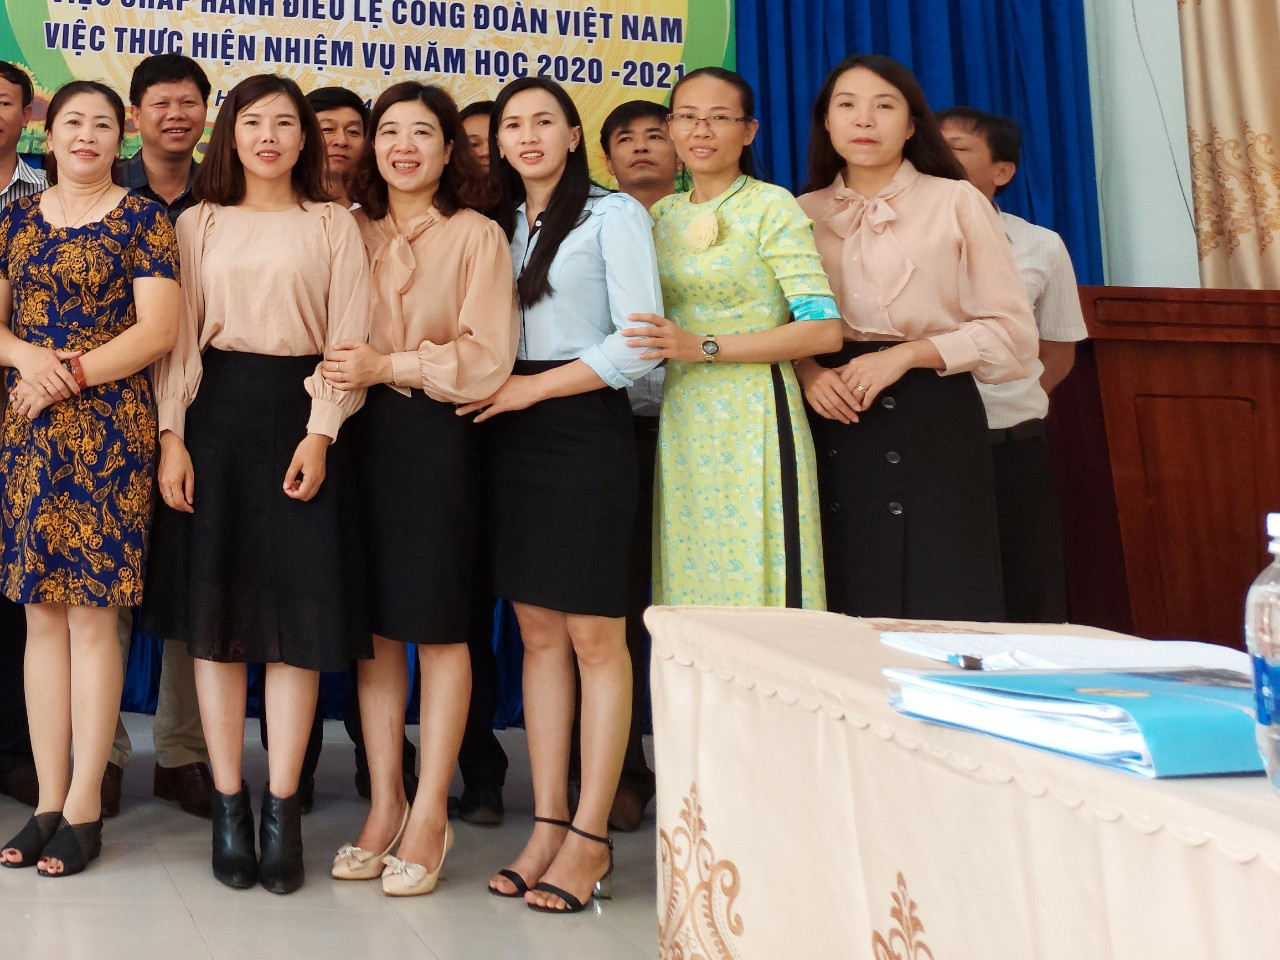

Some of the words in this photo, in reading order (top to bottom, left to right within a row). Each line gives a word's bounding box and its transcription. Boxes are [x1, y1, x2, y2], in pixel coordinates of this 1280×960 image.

[473, 1, 548, 35] ĐOÀN
[555, 7, 614, 43] VIỆT
[621, 14, 684, 44] NAM
[44, 19, 106, 55] VIỆC
[191, 29, 257, 65] HIỆN
[264, 34, 353, 70] NHIỆM
[362, 43, 396, 77] VỤ
[404, 41, 466, 75] NĂM
[474, 49, 529, 83] HỌC
[537, 53, 603, 84] 2020
